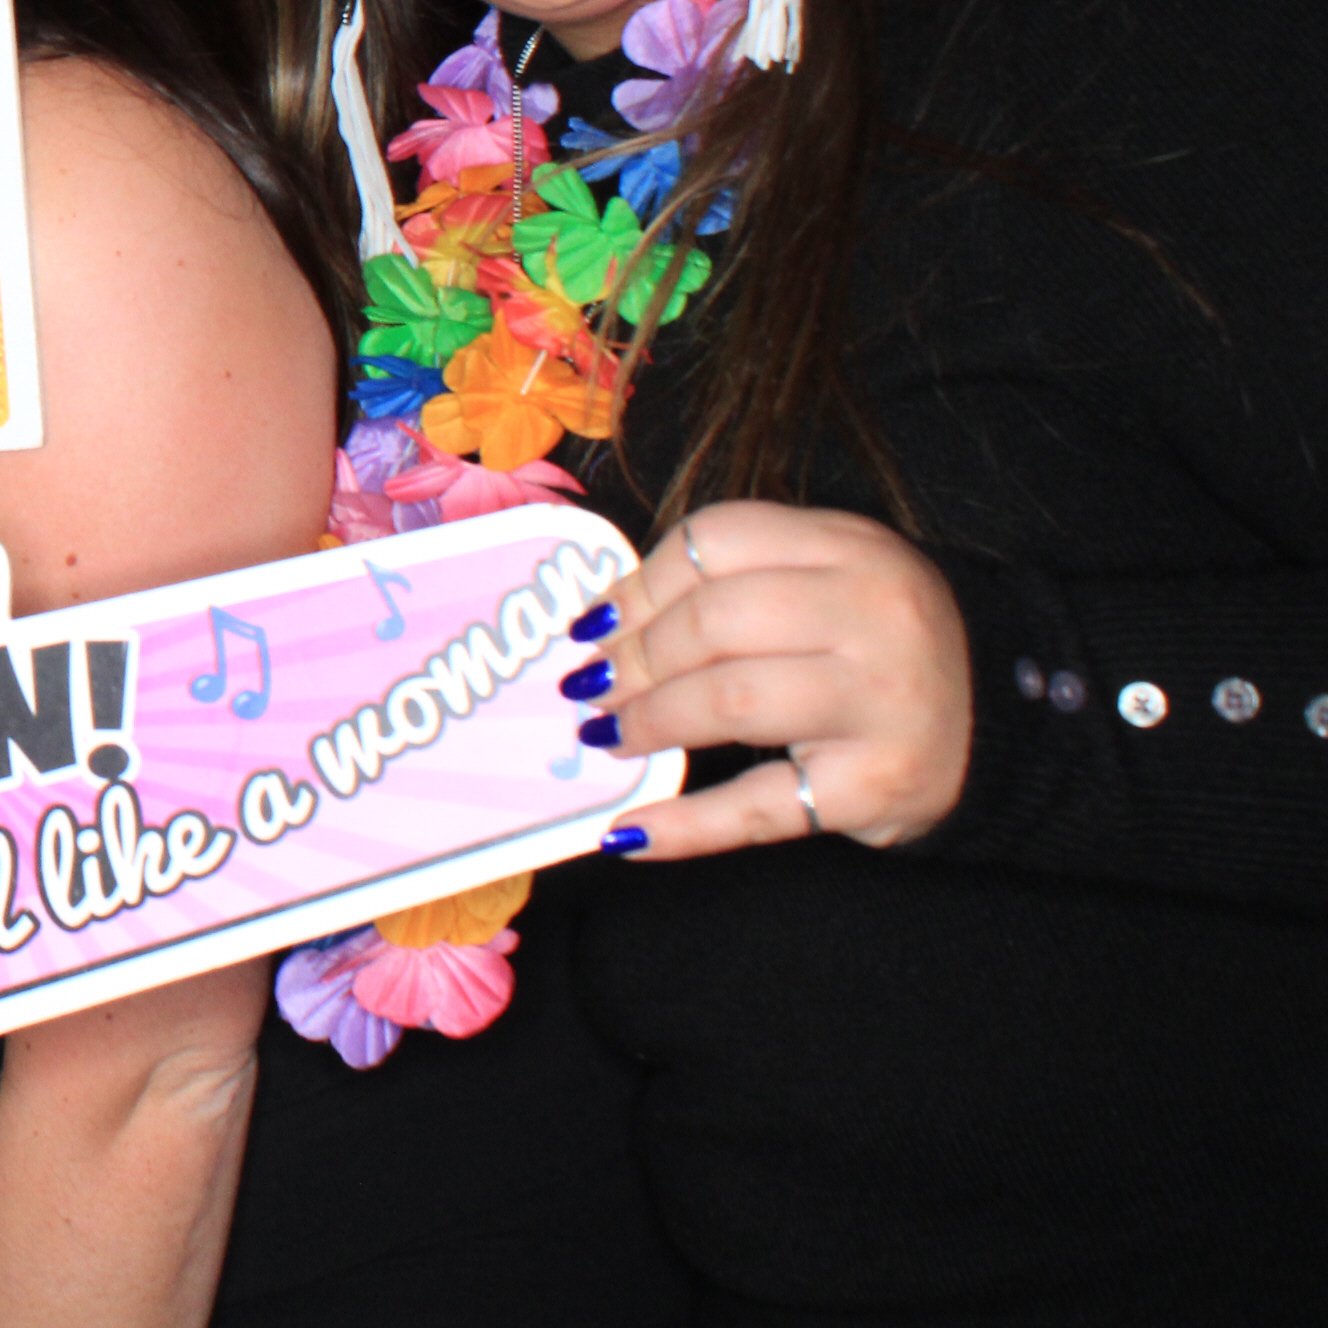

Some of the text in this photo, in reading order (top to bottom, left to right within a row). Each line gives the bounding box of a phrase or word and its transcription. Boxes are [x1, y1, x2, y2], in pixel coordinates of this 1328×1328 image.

[35, 780, 235, 933] like
[237, 770, 317, 846] a
[310, 540, 623, 798] woman
